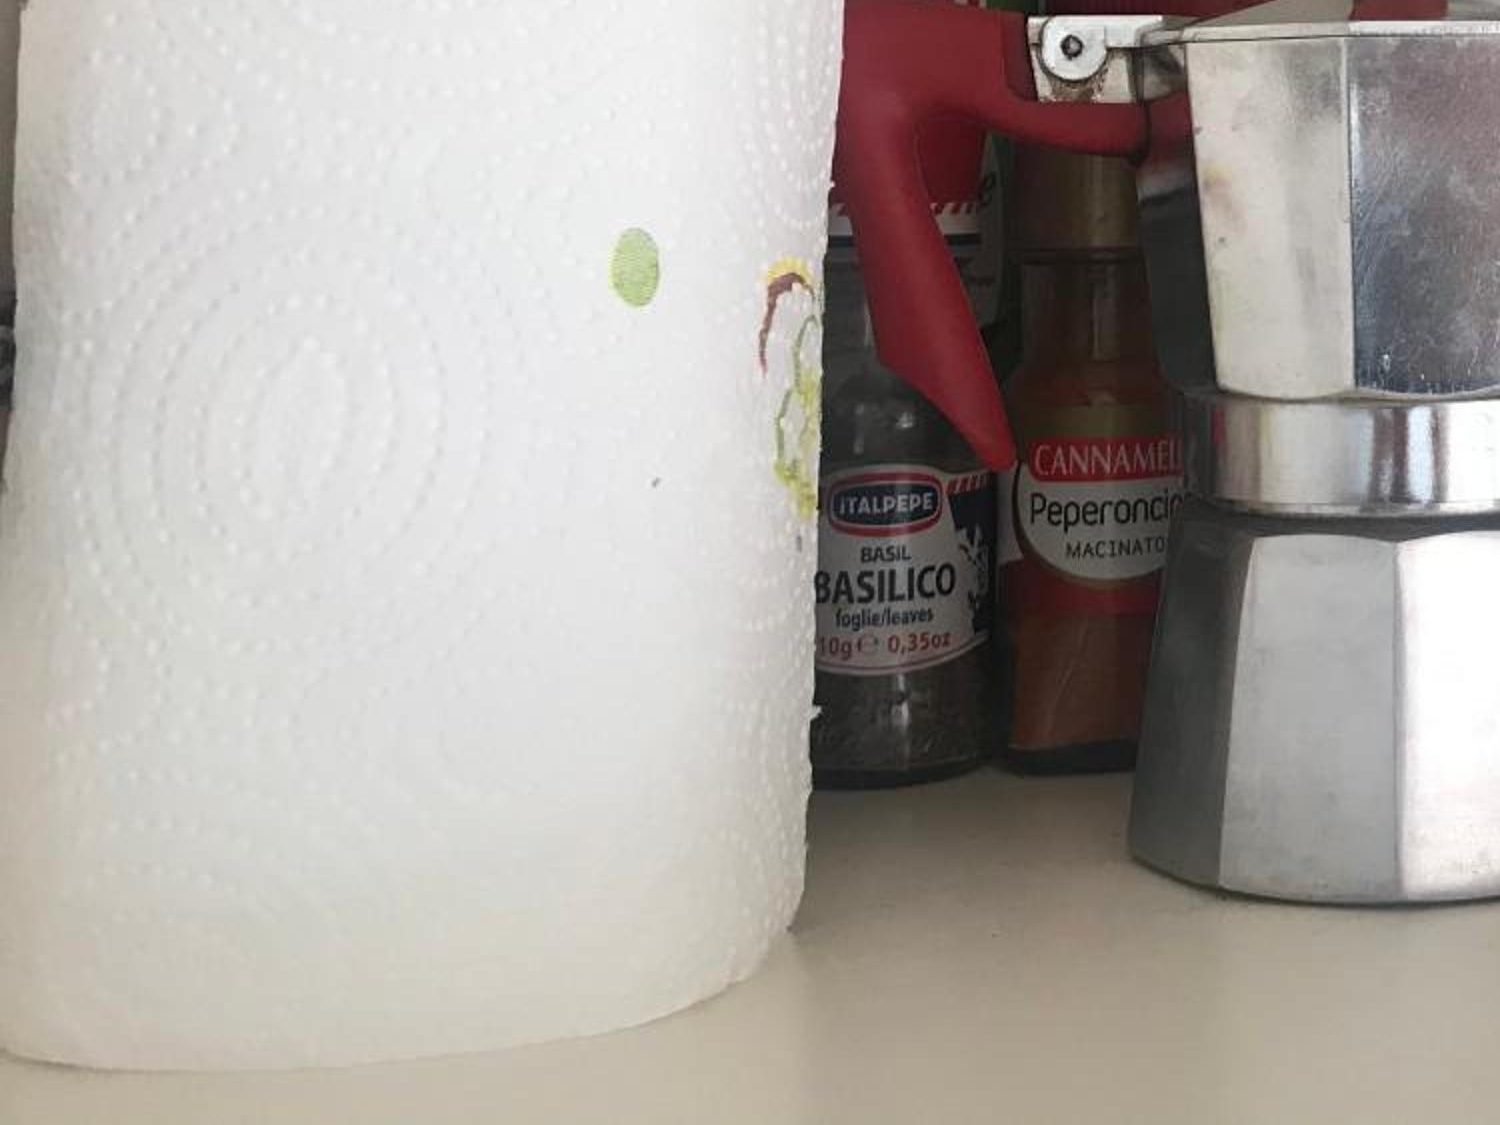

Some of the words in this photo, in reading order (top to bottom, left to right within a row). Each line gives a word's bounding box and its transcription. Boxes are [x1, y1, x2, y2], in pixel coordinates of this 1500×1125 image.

[838, 492, 934, 515] ITALPEPE
[860, 545, 912, 563] BASIL
[1064, 536, 1166, 560] MACINATO
[815, 563, 957, 605] BASILICO
[836, 606, 934, 632] foglie/leaves
